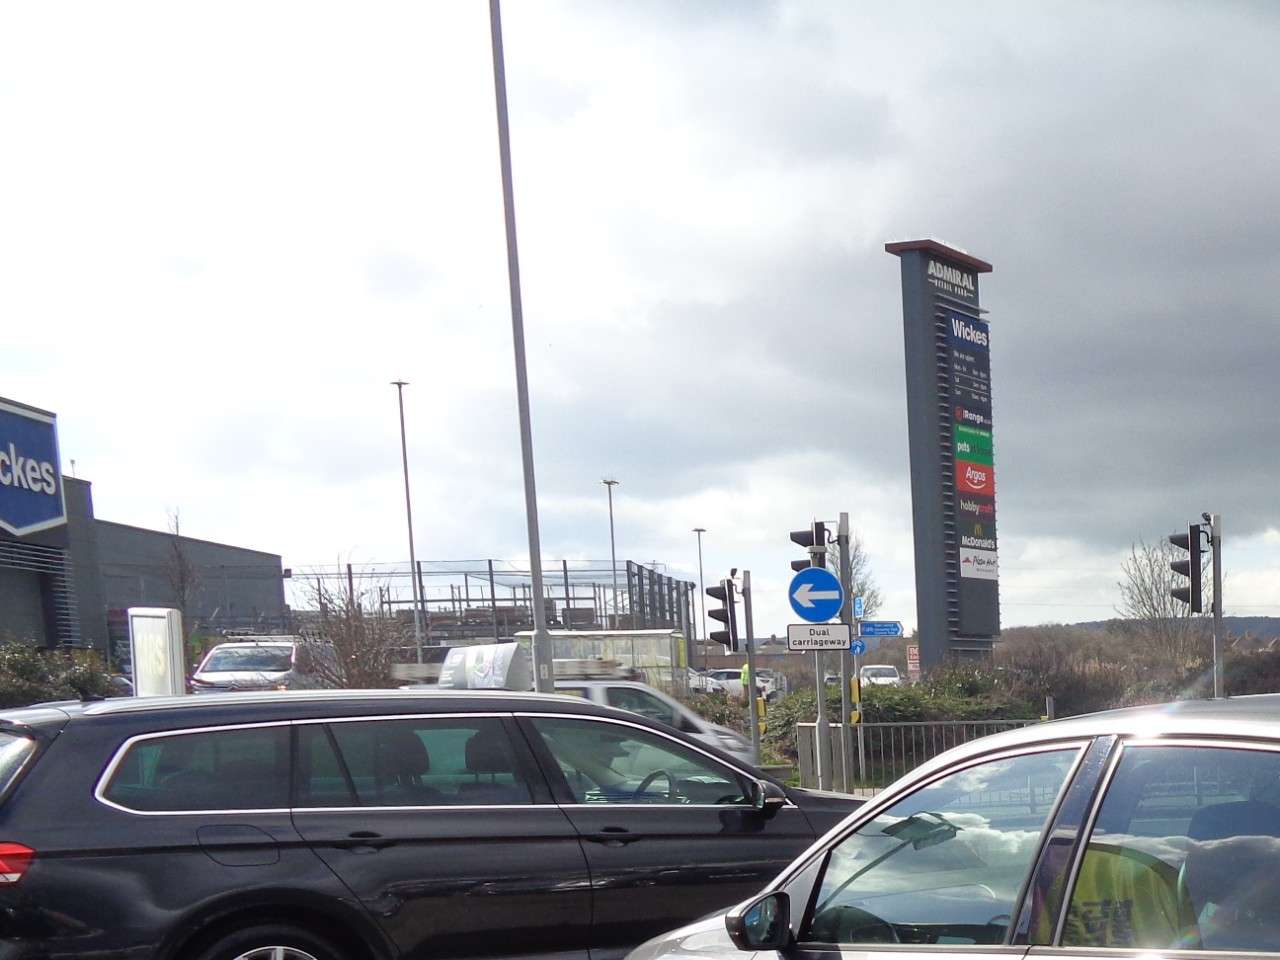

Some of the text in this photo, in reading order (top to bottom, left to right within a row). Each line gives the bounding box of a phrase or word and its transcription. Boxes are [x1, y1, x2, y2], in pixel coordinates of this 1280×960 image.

[928, 260, 974, 290] ADMIRAL
[951, 318, 987, 346] Wickes
[966, 466, 986, 483] Argos
[809, 628, 830, 636] Dual
[792, 637, 847, 647] carriageway
